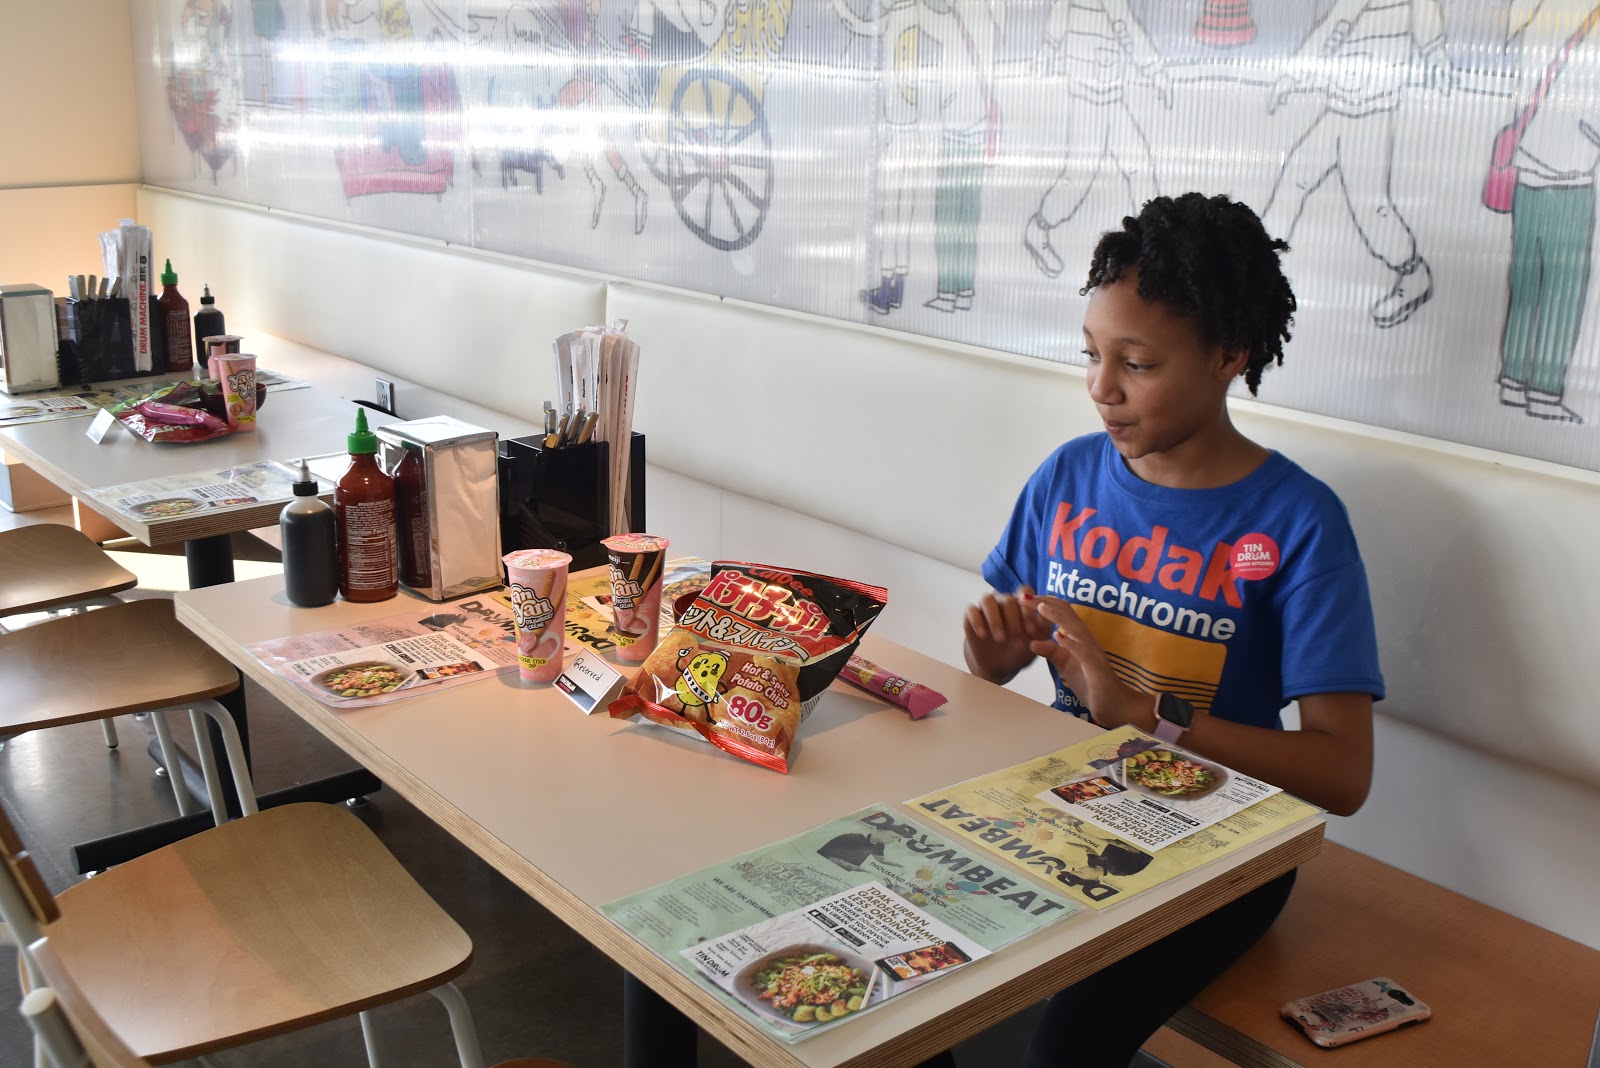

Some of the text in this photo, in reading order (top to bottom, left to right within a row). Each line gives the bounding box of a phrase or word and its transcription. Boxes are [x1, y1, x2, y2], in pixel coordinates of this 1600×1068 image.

[140, 328, 148, 354] DRUM
[1048, 501, 1244, 609] Kodak
[1236, 552, 1270, 562] DRUM
[1243, 544, 1262, 553] TIN
[1046, 560, 1236, 641] Ektachrome
[681, 604, 810, 660] ット&スパイシー
[574, 658, 604, 682] Reserved
[684, 671, 709, 700] POTATO
[742, 662, 791, 698] Hot & Spicy
[730, 673, 764, 692] Potato
[764, 686, 788, 709] Chips
[729, 696, 773, 730] 80g
[758, 735, 776, 749] (80g)
[1063, 828, 1100, 848] THOUSAND
[1092, 814, 1158, 848] TDAK URBAN
[1148, 826, 1173, 840] LESS
[859, 810, 1066, 916] DRUMBEAT
[920, 798, 1121, 902] DRUMBEAT
[806, 866, 843, 882] Movement
[868, 862, 906, 884] THOUSAND
[712, 876, 778, 918] WE ARE TIN DRUMME
[867, 886, 894, 904] TDAK
[893, 903, 930, 927] URBAN
[826, 902, 891, 945] EVERYTIME YOU DEVOUR
[829, 911, 849, 925] URBAN
[848, 924, 870, 940] GARDEN
[840, 898, 855, 908] SIGN
[854, 905, 864, 913] UP
[862, 911, 874, 920] FOR
[881, 924, 908, 942] REWARDS
[840, 902, 860, 918] RECEIVE
[860, 916, 881, 932] DOUBLE
[881, 930, 897, 941] HEAT
[848, 894, 870, 910] LESS
[870, 908, 923, 944] ORDINARY.
[858, 890, 899, 919] GARDEN.
[900, 918, 946, 946] SUMMER
[696, 950, 710, 962] TIN
[706, 958, 730, 978] DRUM
